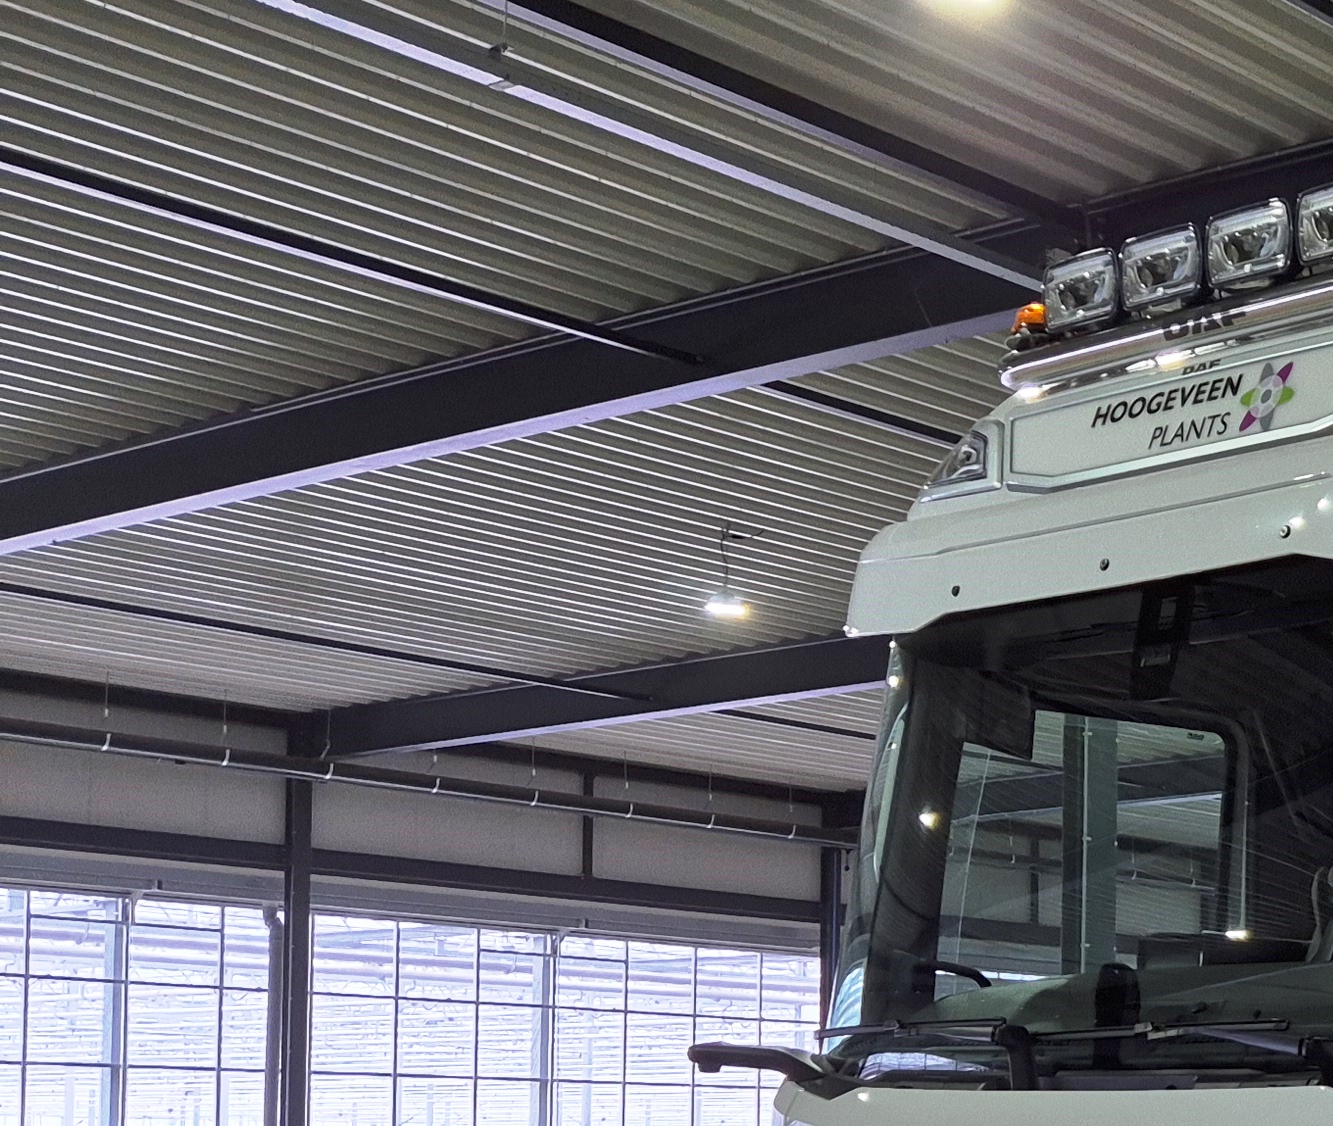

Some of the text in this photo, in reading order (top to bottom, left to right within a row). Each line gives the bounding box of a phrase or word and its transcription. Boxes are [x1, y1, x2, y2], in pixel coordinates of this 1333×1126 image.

[1182, 359, 1222, 376] DAF
[1091, 373, 1244, 428] HOOGEVEEN
[1148, 411, 1231, 449] PLANTS
